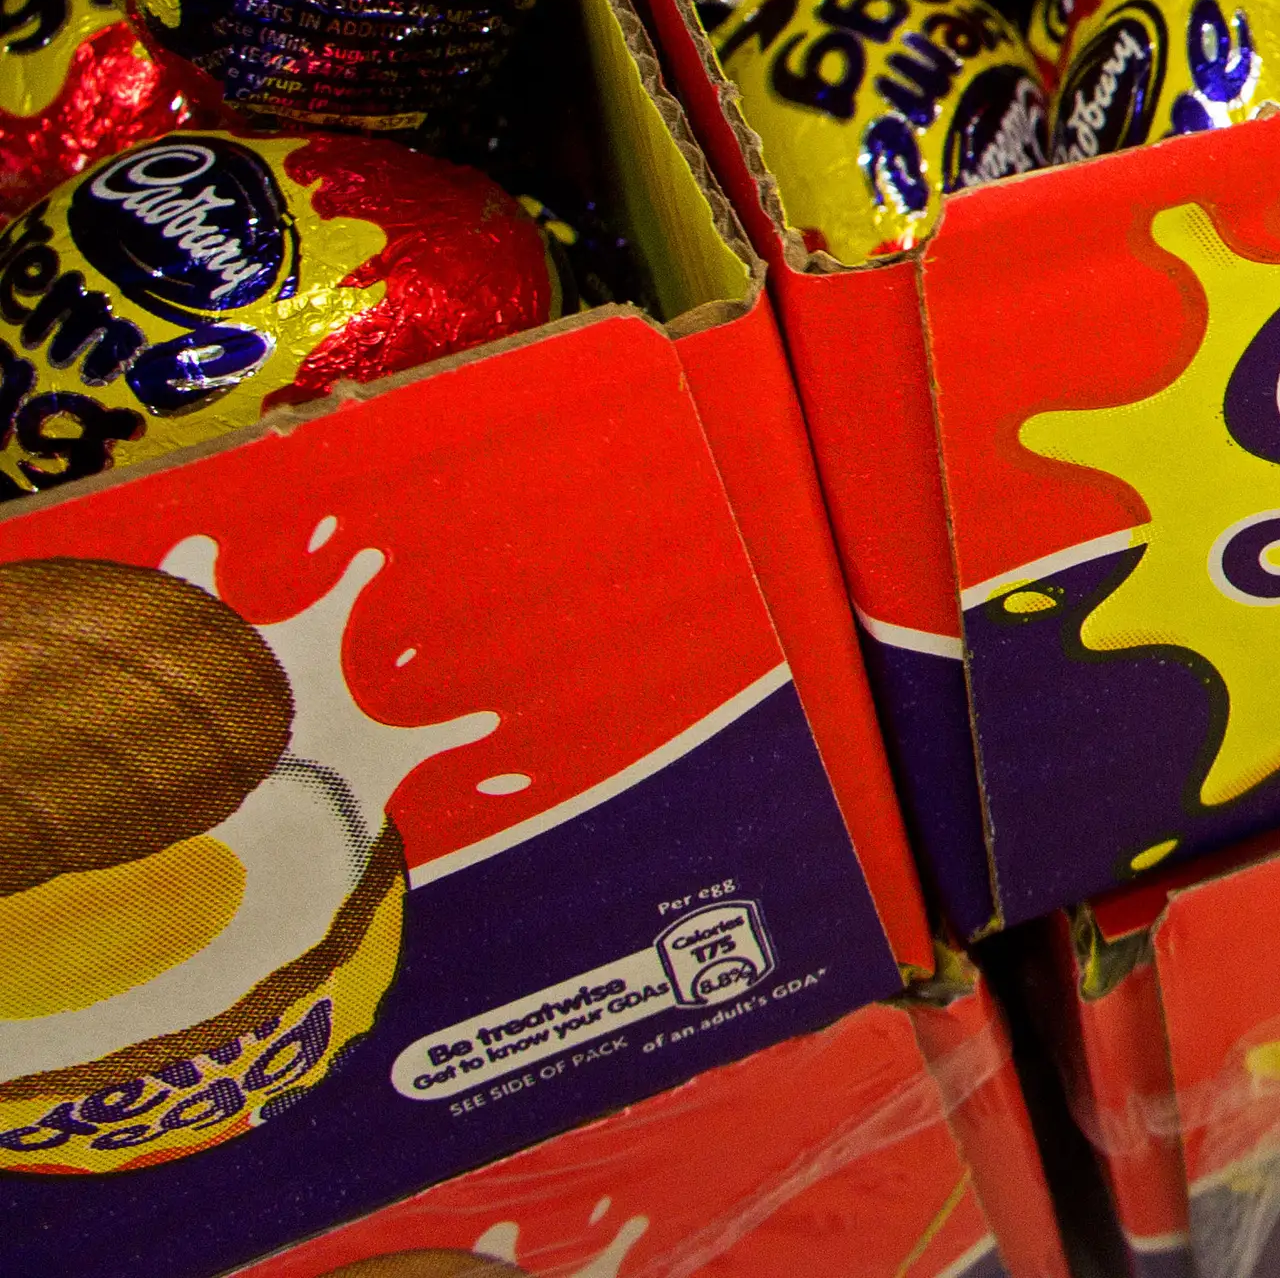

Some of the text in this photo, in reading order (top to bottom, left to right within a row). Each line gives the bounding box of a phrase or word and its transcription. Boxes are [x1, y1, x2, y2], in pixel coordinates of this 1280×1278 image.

[87, 142, 276, 302] Cadbury
[657, 878, 736, 917] Per egg
[670, 913, 746, 952] Calories
[689, 935, 736, 966] 175
[699, 966, 757, 996] 8.8%
[412, 980, 672, 1093] Get to know your GDAs
[427, 976, 628, 1068] Be treatwise
[641, 1032, 667, 1056] of
[669, 1023, 696, 1043] an
[699, 994, 770, 1032] adult's
[448, 1034, 631, 1119] SEE SIDE OF PACK
